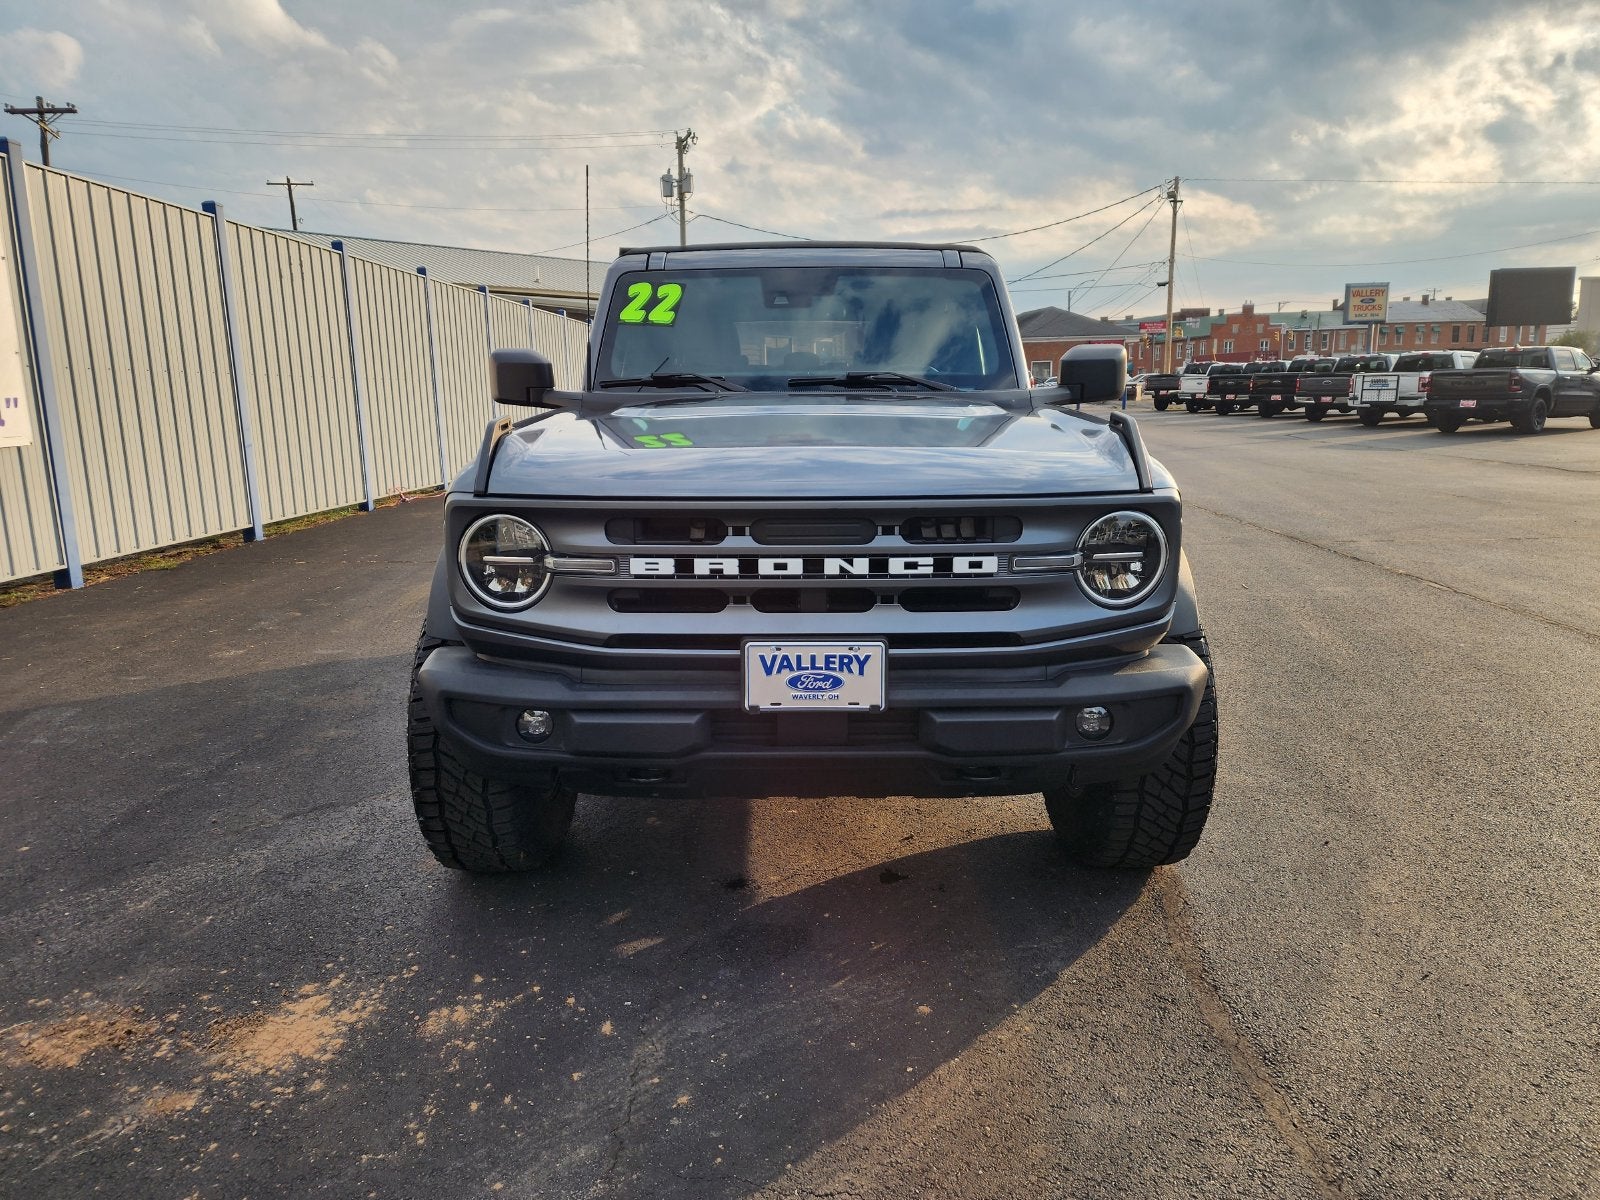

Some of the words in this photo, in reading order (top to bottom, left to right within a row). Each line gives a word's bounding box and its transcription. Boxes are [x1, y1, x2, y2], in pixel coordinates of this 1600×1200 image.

[1351, 288, 1385, 298] VALLERY
[620, 282, 682, 324] 22
[1353, 303, 1383, 312] TRUCKS
[629, 556, 999, 576] BRONCO
[758, 653, 872, 676] VALLERY
[796, 671, 833, 689] Ford
[791, 693, 827, 701] WAVERLY,
